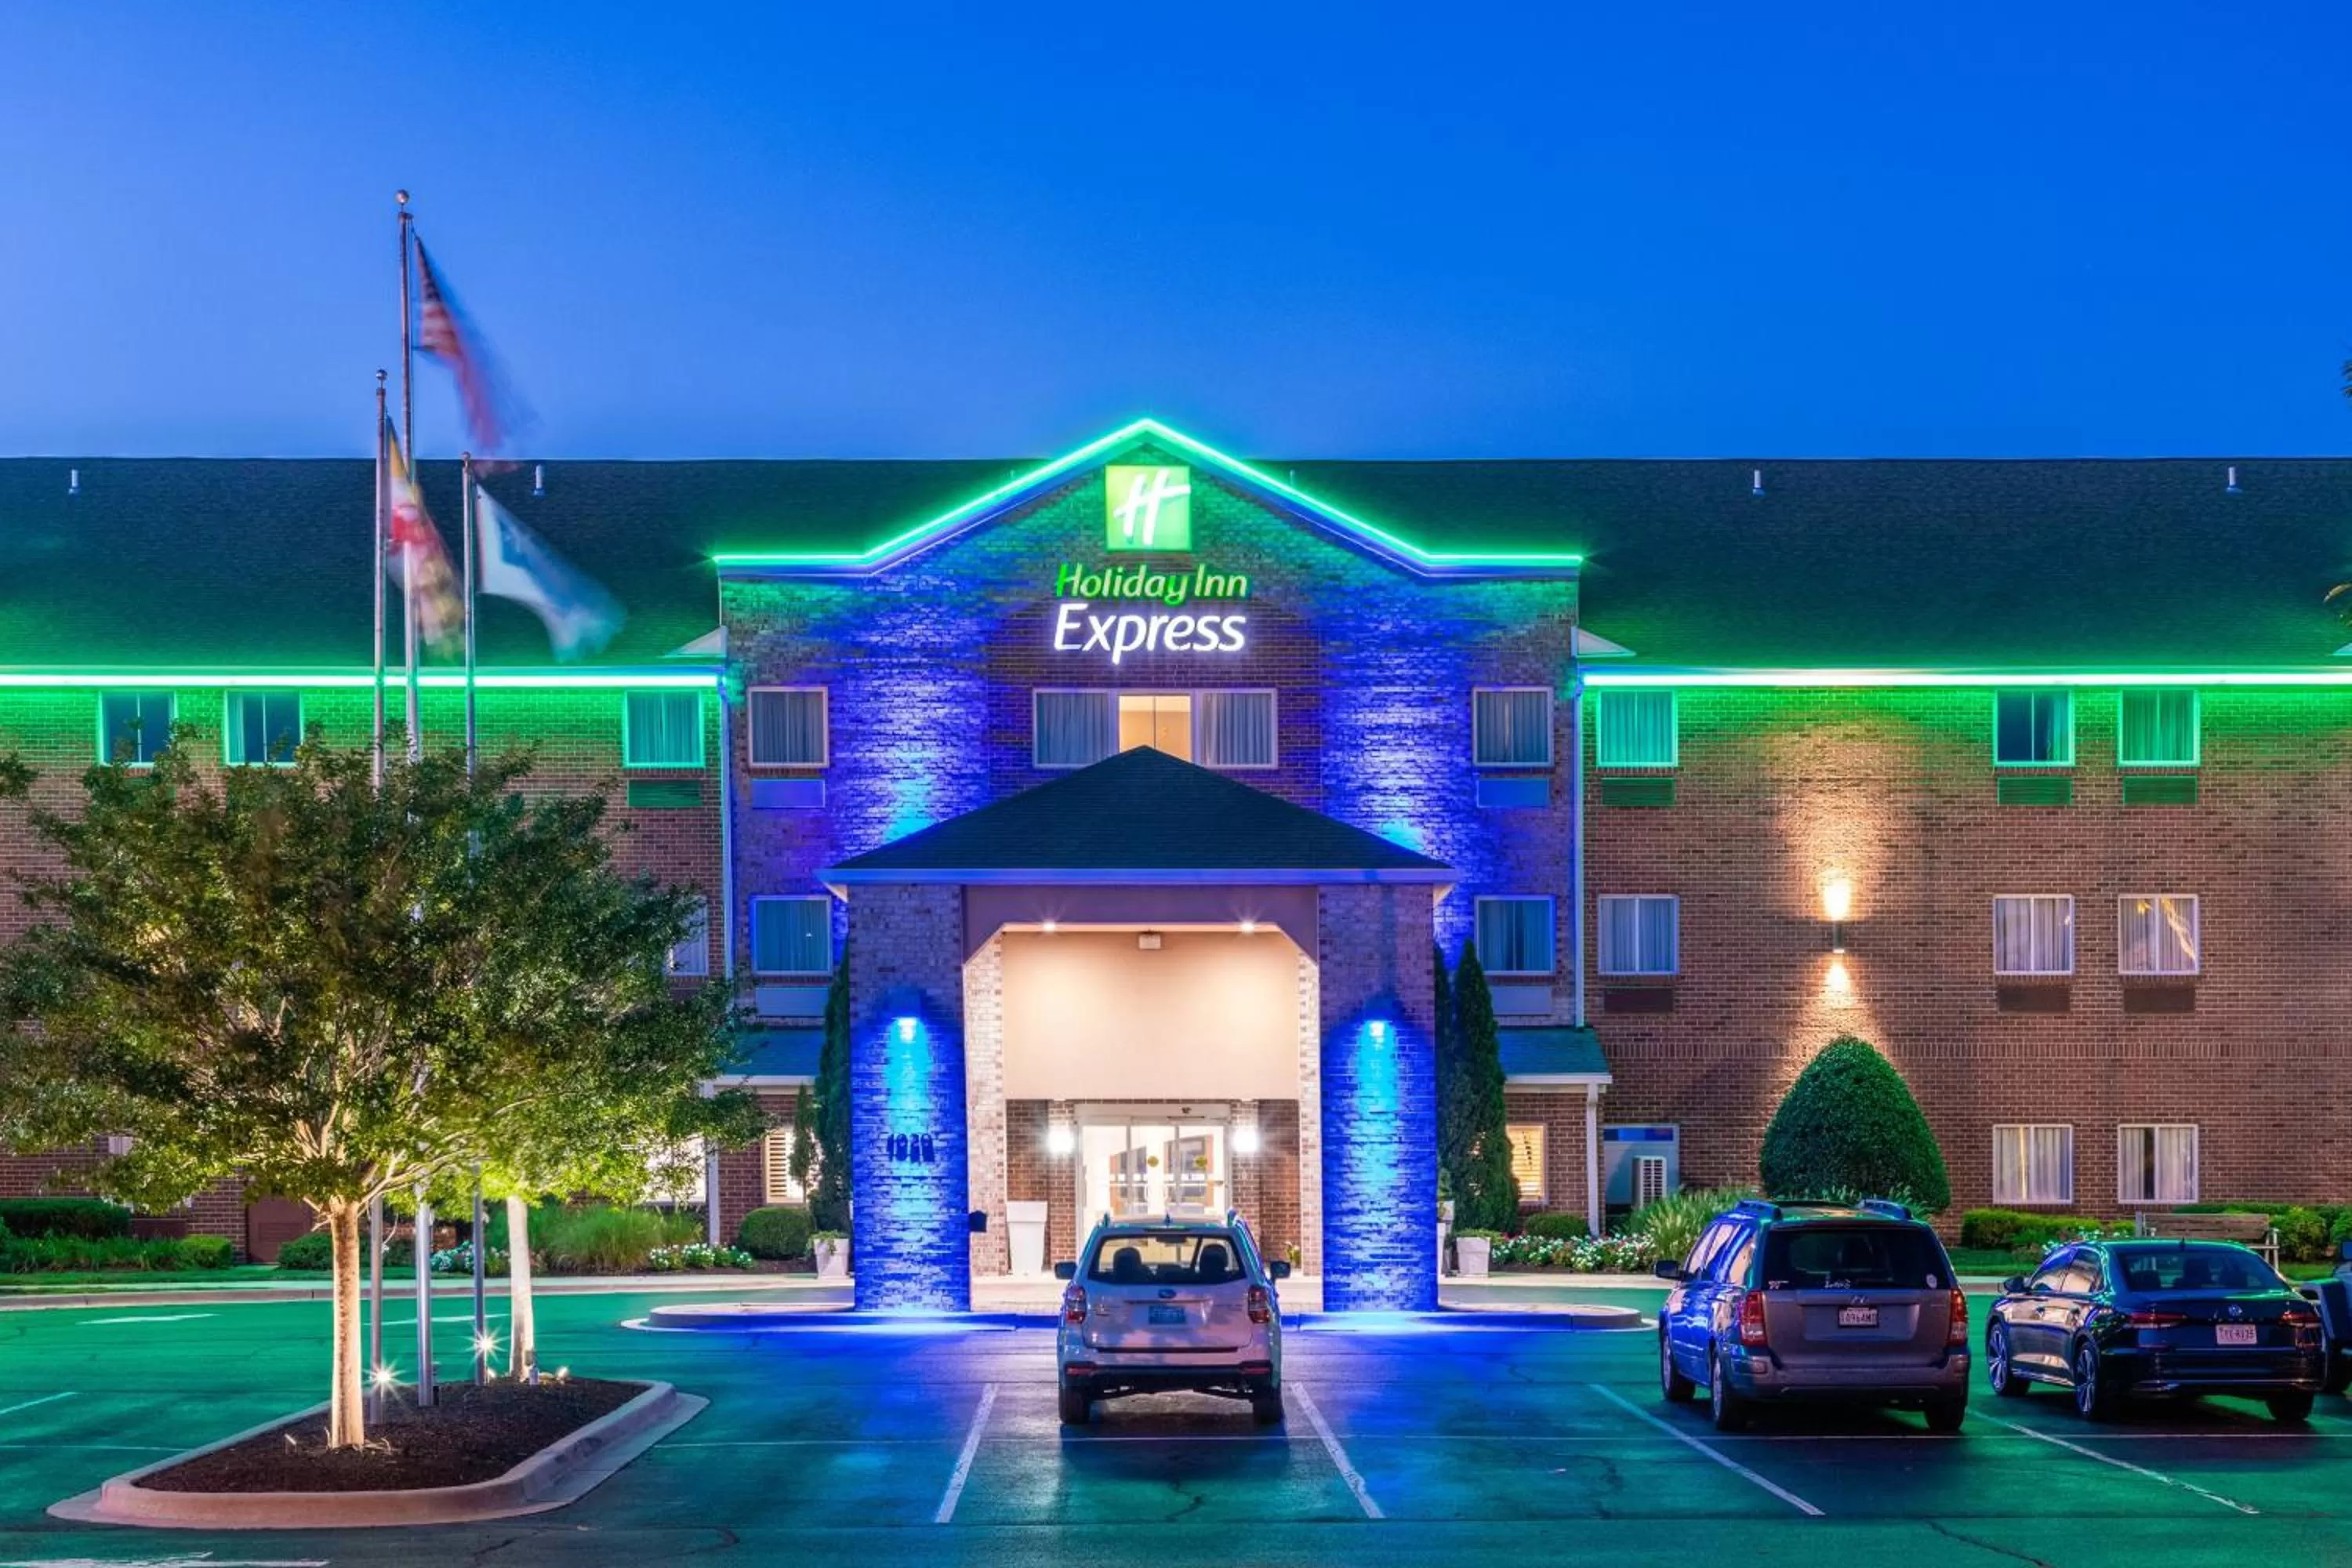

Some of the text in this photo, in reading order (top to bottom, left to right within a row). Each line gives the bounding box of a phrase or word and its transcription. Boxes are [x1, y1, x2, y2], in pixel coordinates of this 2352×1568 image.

[1113, 469, 1191, 546] H
[1056, 562, 1247, 605] Holiday Inn
[1054, 603, 1247, 665] Express
